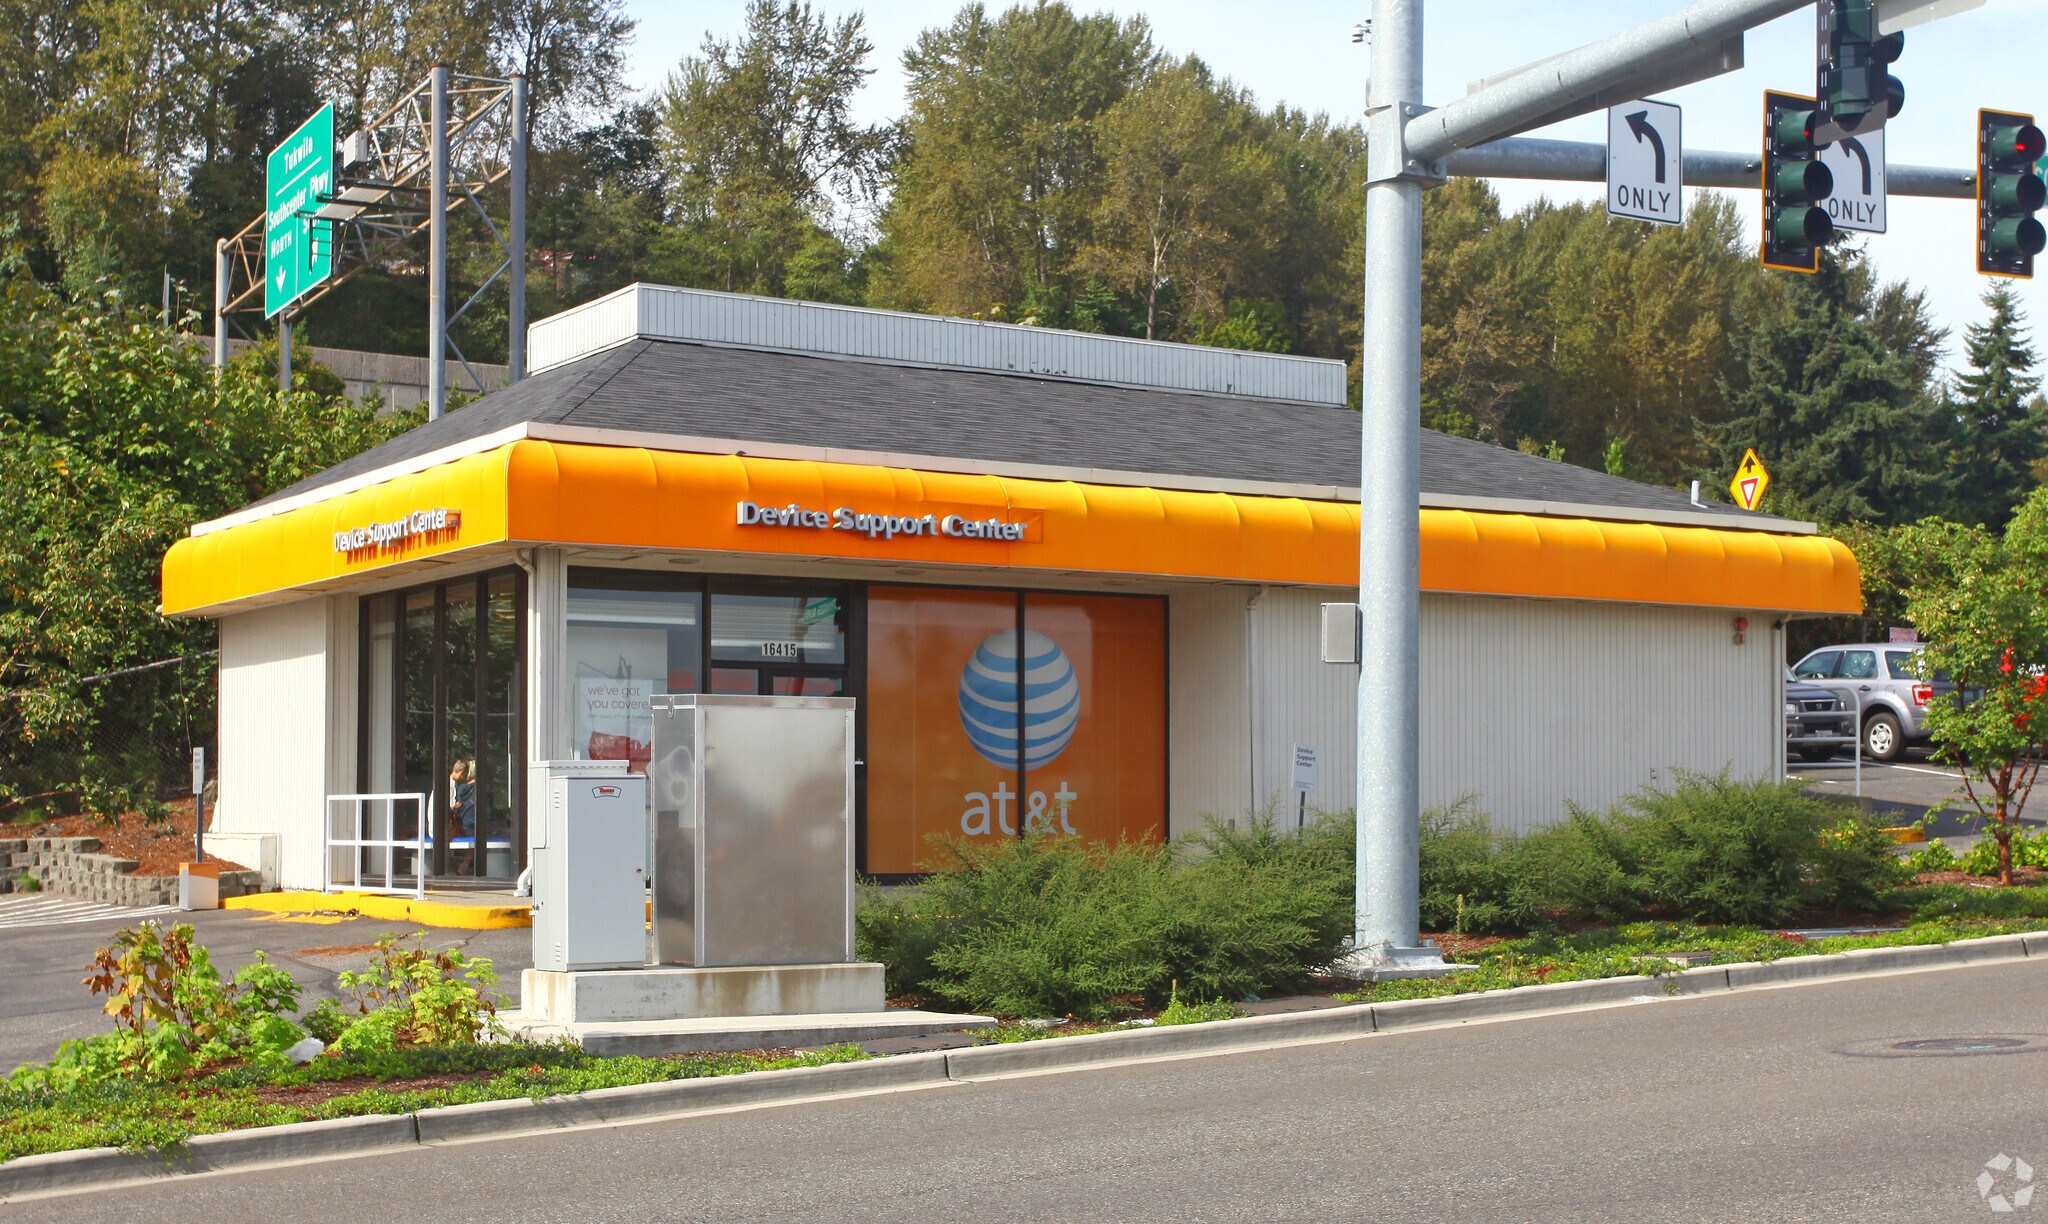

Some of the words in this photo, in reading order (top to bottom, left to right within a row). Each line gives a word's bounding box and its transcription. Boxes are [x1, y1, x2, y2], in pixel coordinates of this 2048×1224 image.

[284, 137, 313, 174] Tukwila
[269, 187, 307, 232] Southcenter
[310, 169, 330, 199] Pkwy
[1618, 184, 1670, 214] ONLY
[1828, 198, 1877, 224] ONLY
[271, 230, 293, 260] NORTH
[334, 527, 366, 553] Device
[367, 515, 408, 548] Support
[411, 508, 448, 533] Center
[737, 501, 829, 529] Device
[833, 507, 938, 540] Support
[941, 513, 1027, 541] Center
[763, 643, 797, 656] 16415
[587, 700, 608, 712] you
[611, 700, 653, 711] covere
[588, 685, 618, 696] we've
[622, 686, 640, 699] got
[1296, 746, 1314, 755] Device
[1296, 754, 1316, 762] Support
[1296, 760, 1313, 768] Center
[961, 781, 1077, 836] at&t
